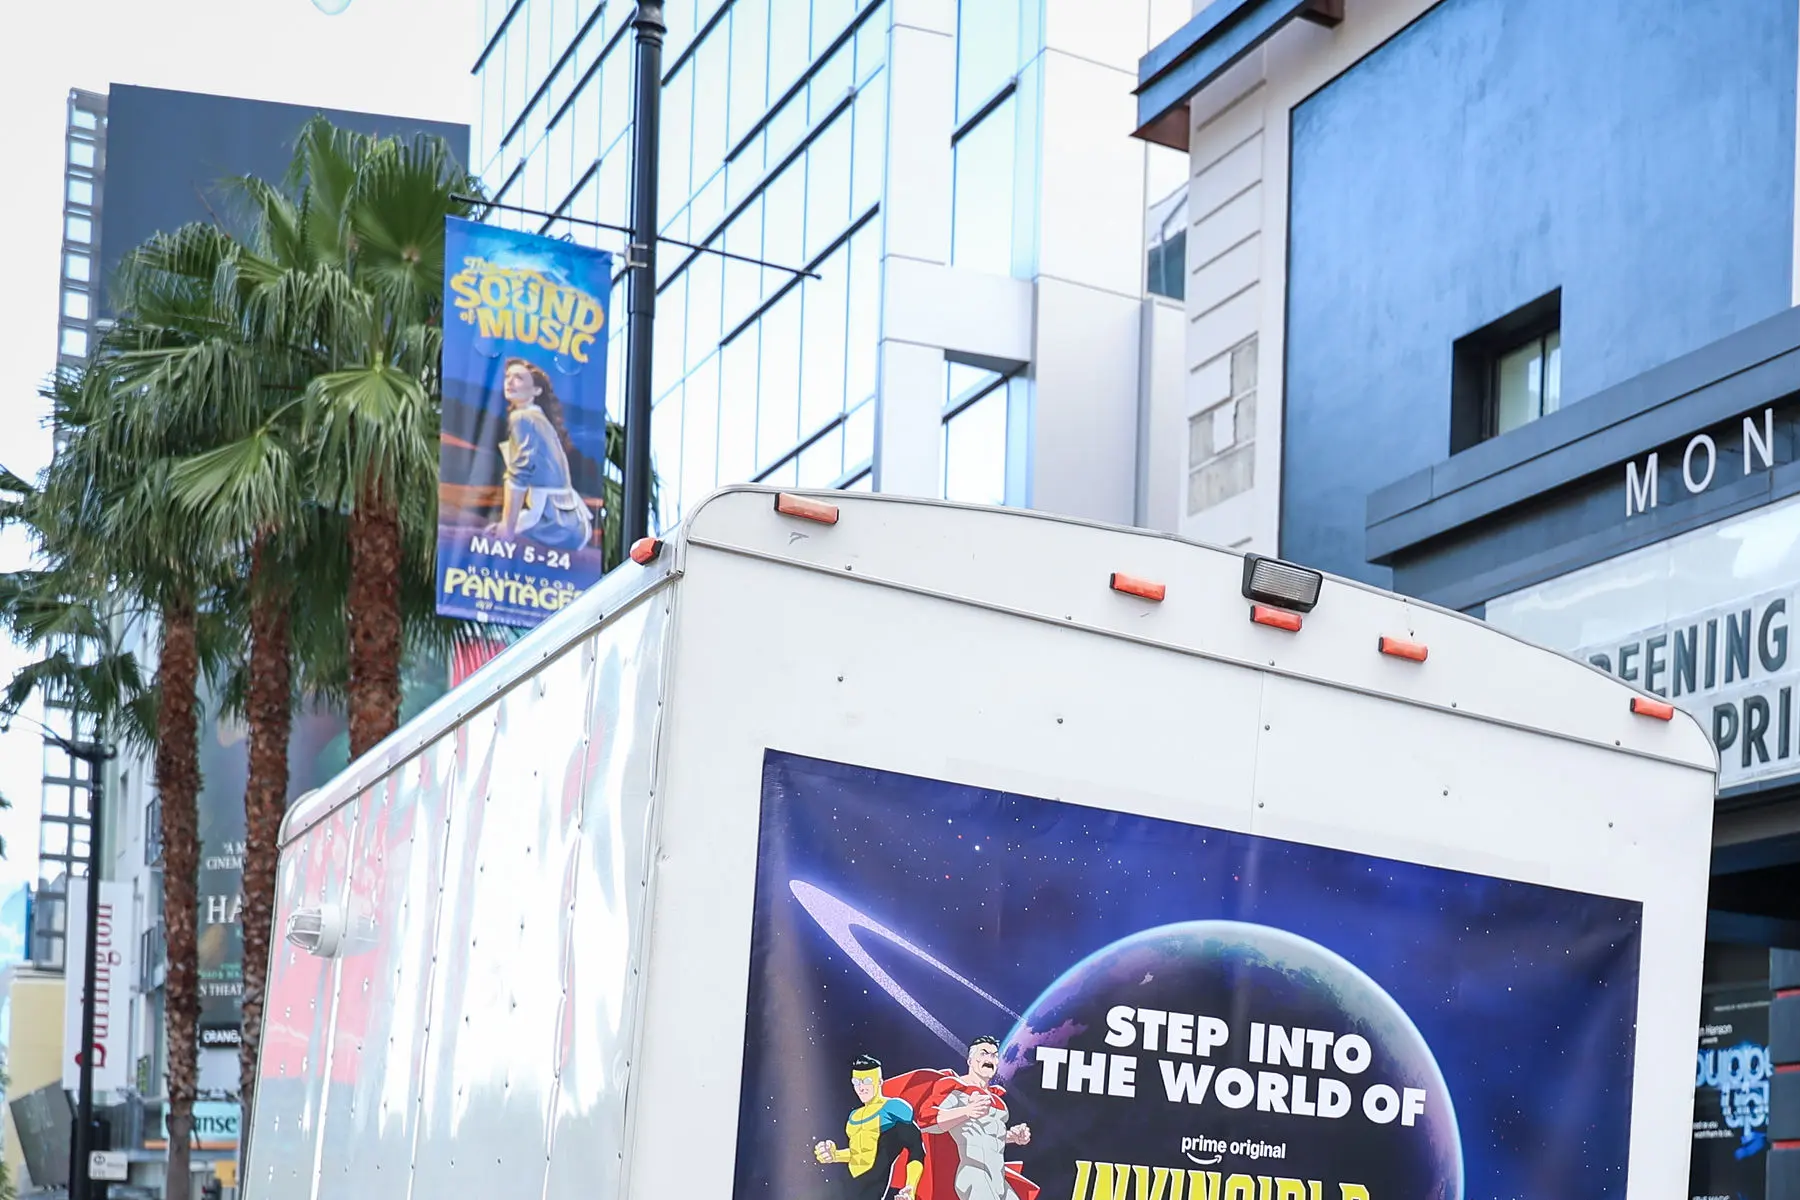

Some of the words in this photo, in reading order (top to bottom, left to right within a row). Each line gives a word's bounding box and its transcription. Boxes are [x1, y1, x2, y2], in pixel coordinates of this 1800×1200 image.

[450, 270, 604, 335] SOUND
[476, 308, 596, 363] MUSIC
[470, 536, 517, 559] MAY
[523, 546, 572, 571] 5-24
[1589, 597, 1789, 699] EENING
[1104, 1004, 1230, 1058] STEP
[1248, 1022, 1373, 1075] INTO
[1036, 1046, 1138, 1099] THE
[1157, 1058, 1353, 1119] WORLD
[1362, 1083, 1428, 1128] OF
[1181, 1134, 1227, 1154] prime
[1229, 1139, 1286, 1160] original
